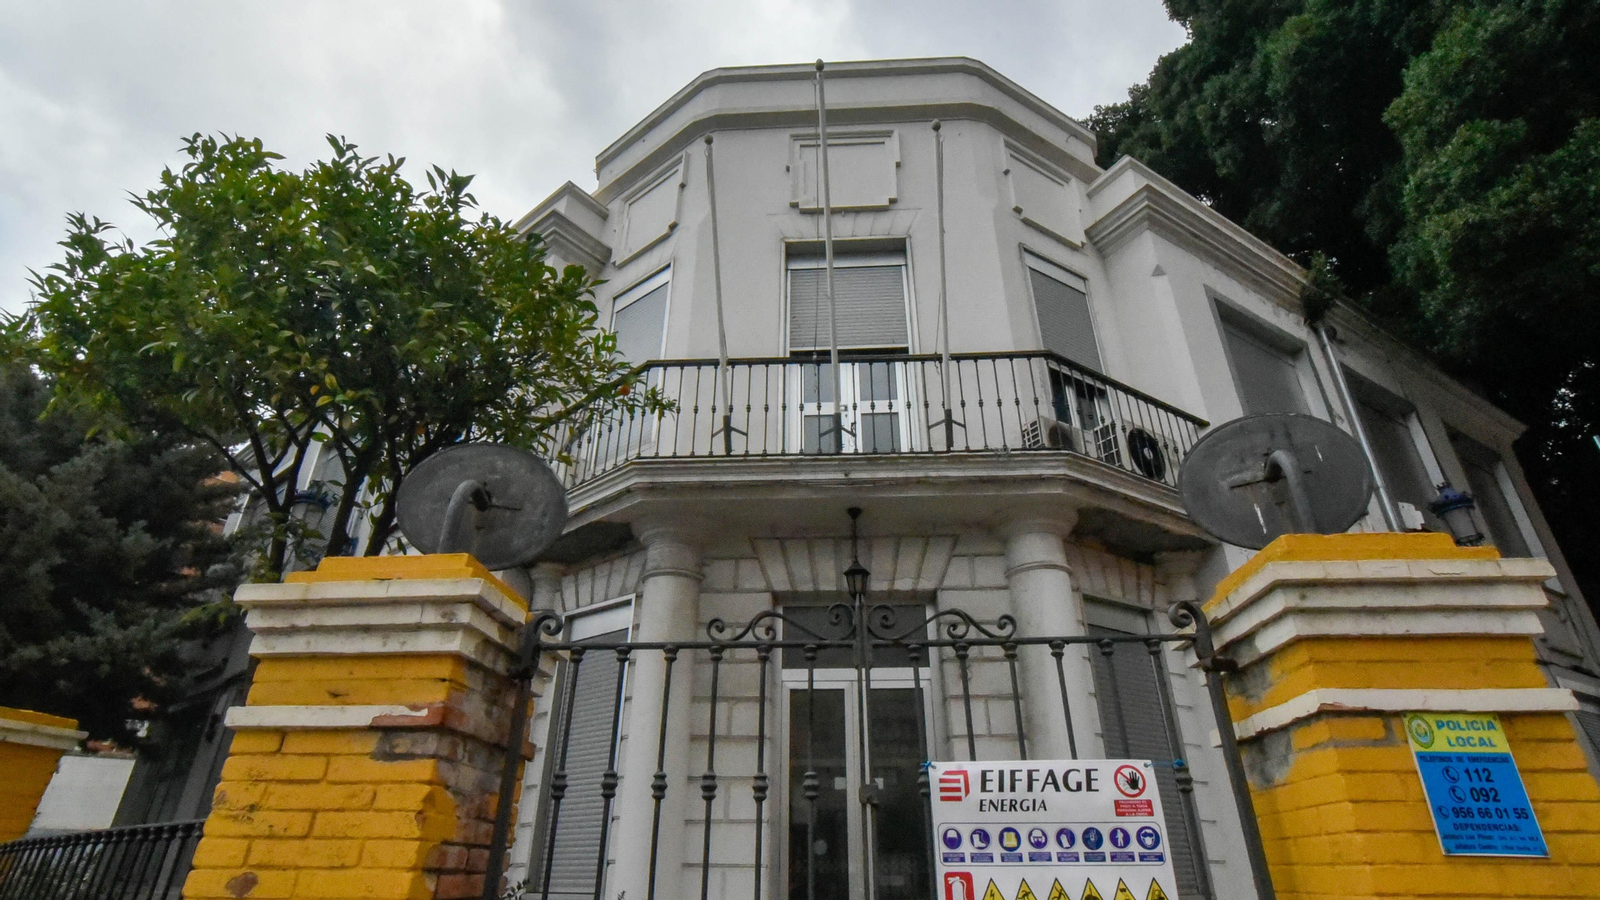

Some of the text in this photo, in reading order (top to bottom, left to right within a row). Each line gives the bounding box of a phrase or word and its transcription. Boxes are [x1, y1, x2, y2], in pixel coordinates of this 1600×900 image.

[1435, 720, 1497, 731] POLICIA
[1446, 735, 1497, 748] LOCAL
[980, 768, 1100, 793] EIFFAGE
[1464, 768, 1495, 783] 112
[1470, 787, 1501, 803] 092
[979, 798, 1048, 812] ENERGIA
[1452, 806, 1529, 820] 956 66 01 55
[1453, 823, 1522, 832] DEPENDENCIAS:
